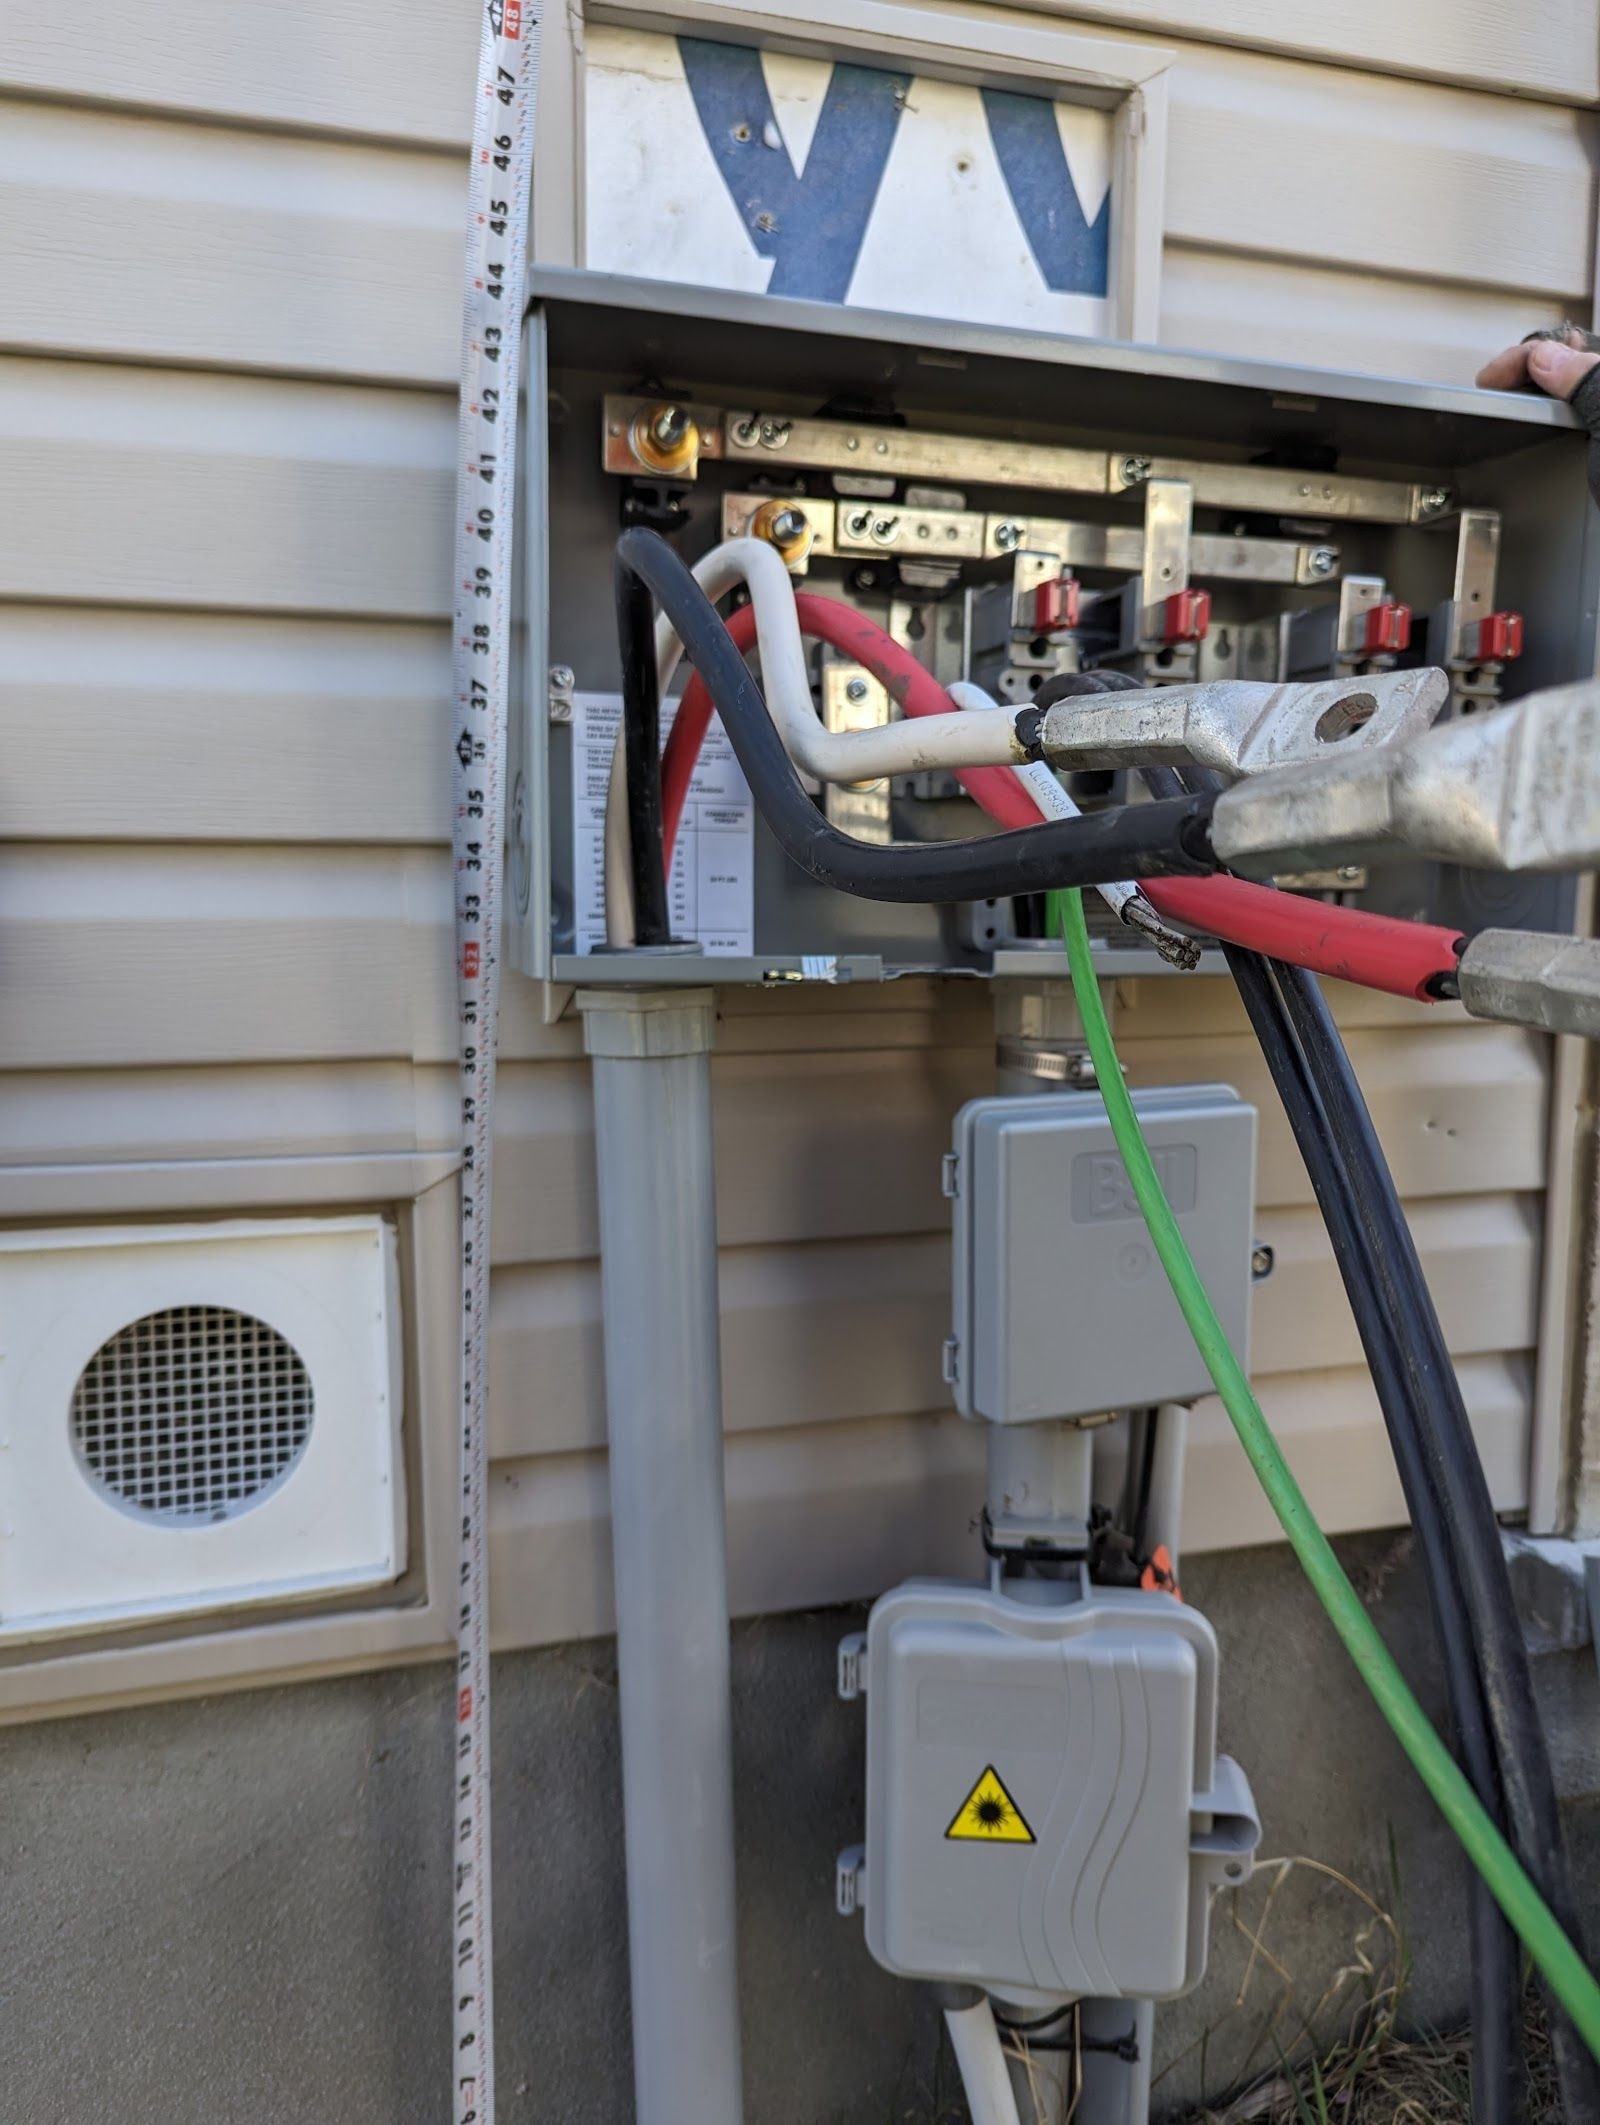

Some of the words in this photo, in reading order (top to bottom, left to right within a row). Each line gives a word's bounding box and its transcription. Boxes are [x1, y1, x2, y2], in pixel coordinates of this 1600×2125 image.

[497, 66, 515, 106] 47
[480, 151, 490, 165] 10
[493, 135, 512, 172] 46
[490, 200, 509, 237] 45
[487, 263, 505, 301] 44
[485, 327, 502, 363] 43
[481, 388, 499, 424] 42
[480, 453, 497, 484] 41
[477, 508, 495, 543] 40
[474, 567, 493, 599] 39
[472, 624, 490, 656] 38
[470, 678, 488, 711] 37
[473, 742, 486, 760] 36
[467, 789, 484, 819] 35
[466, 842, 482, 871] 34
[465, 894, 481, 923] 33
[464, 1001, 478, 1025] 31
[464, 1046, 477, 1075] 30
[464, 1097, 476, 1123] 29
[458, 1938, 474, 1967] 10
[459, 2032, 476, 2050] 8
[459, 2077, 476, 2091] 7
[460, 2110, 477, 2125] 6
